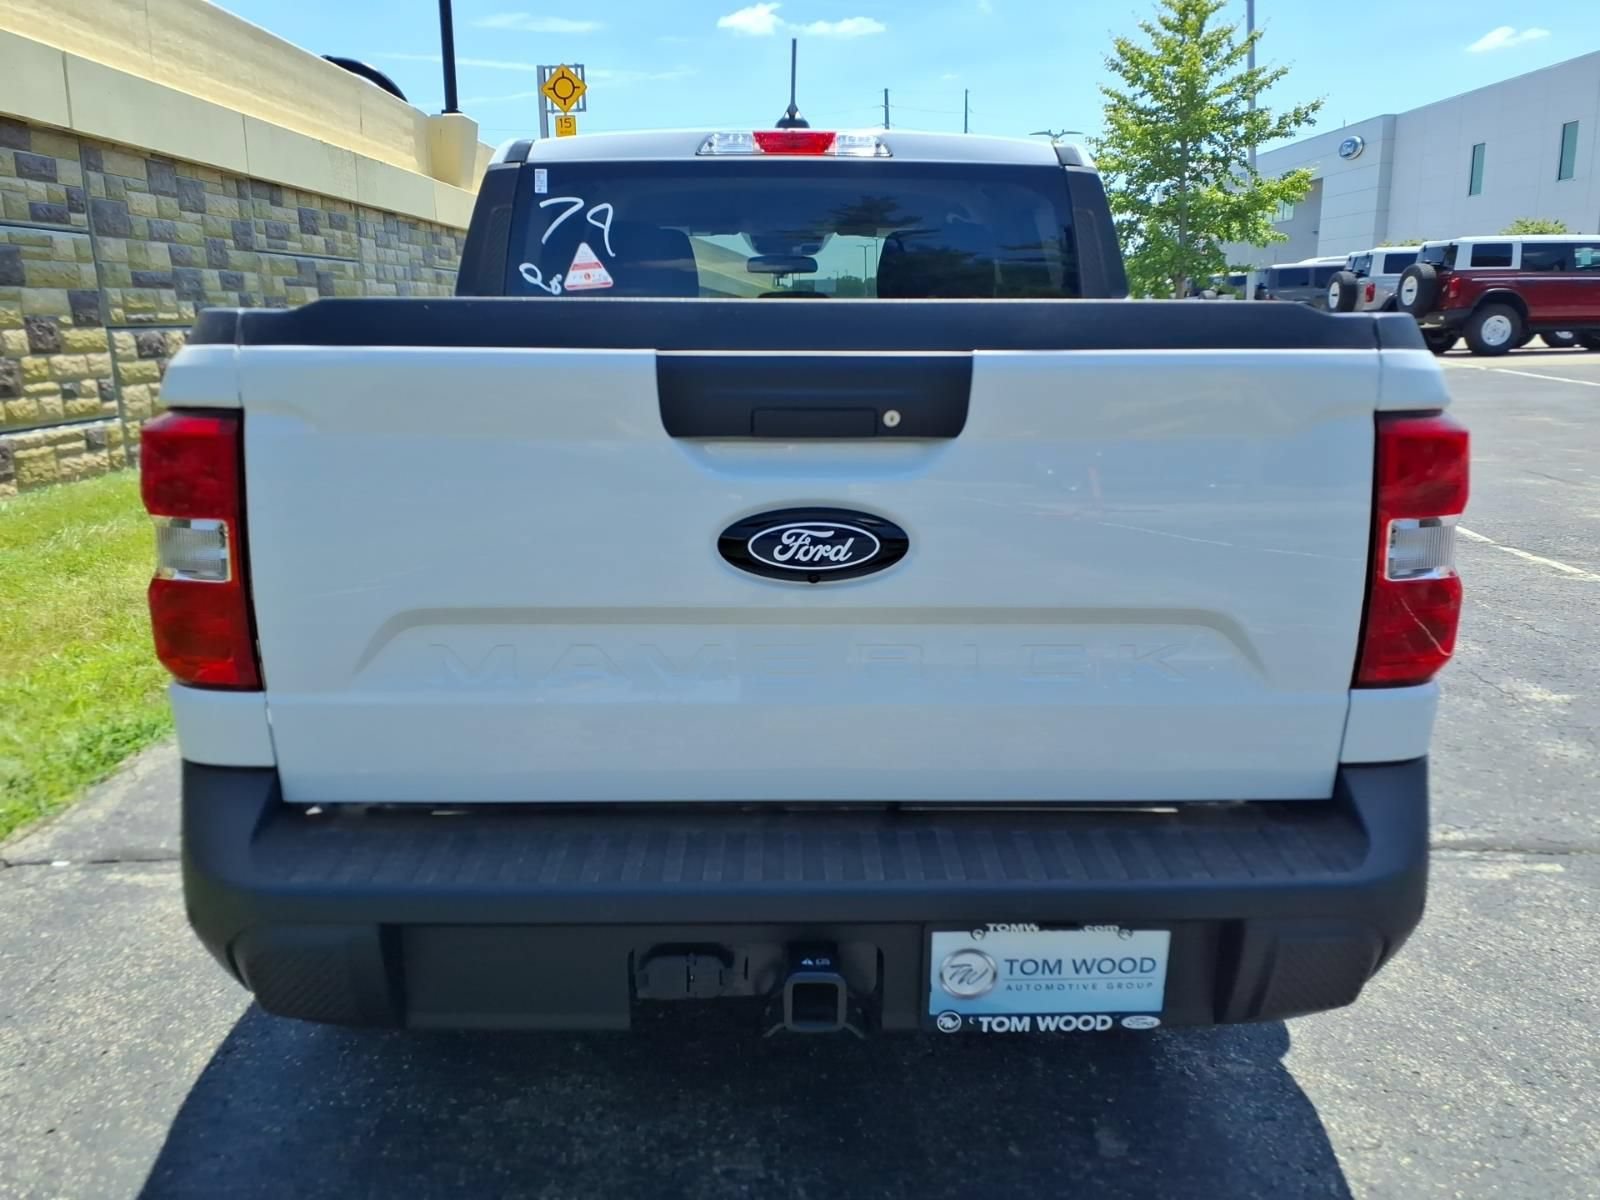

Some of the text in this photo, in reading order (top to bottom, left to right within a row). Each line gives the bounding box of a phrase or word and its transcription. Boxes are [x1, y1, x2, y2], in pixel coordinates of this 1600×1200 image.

[559, 117, 572, 129] 15
[539, 196, 616, 258] 79
[773, 528, 855, 562] Ford
[426, 640, 1191, 688] MAVERICK
[1004, 957, 1156, 976] TOM WOOD
[1005, 982, 1153, 992] AUTOMOTIVE GROUP
[978, 1014, 1113, 1033] TOM WOOD
